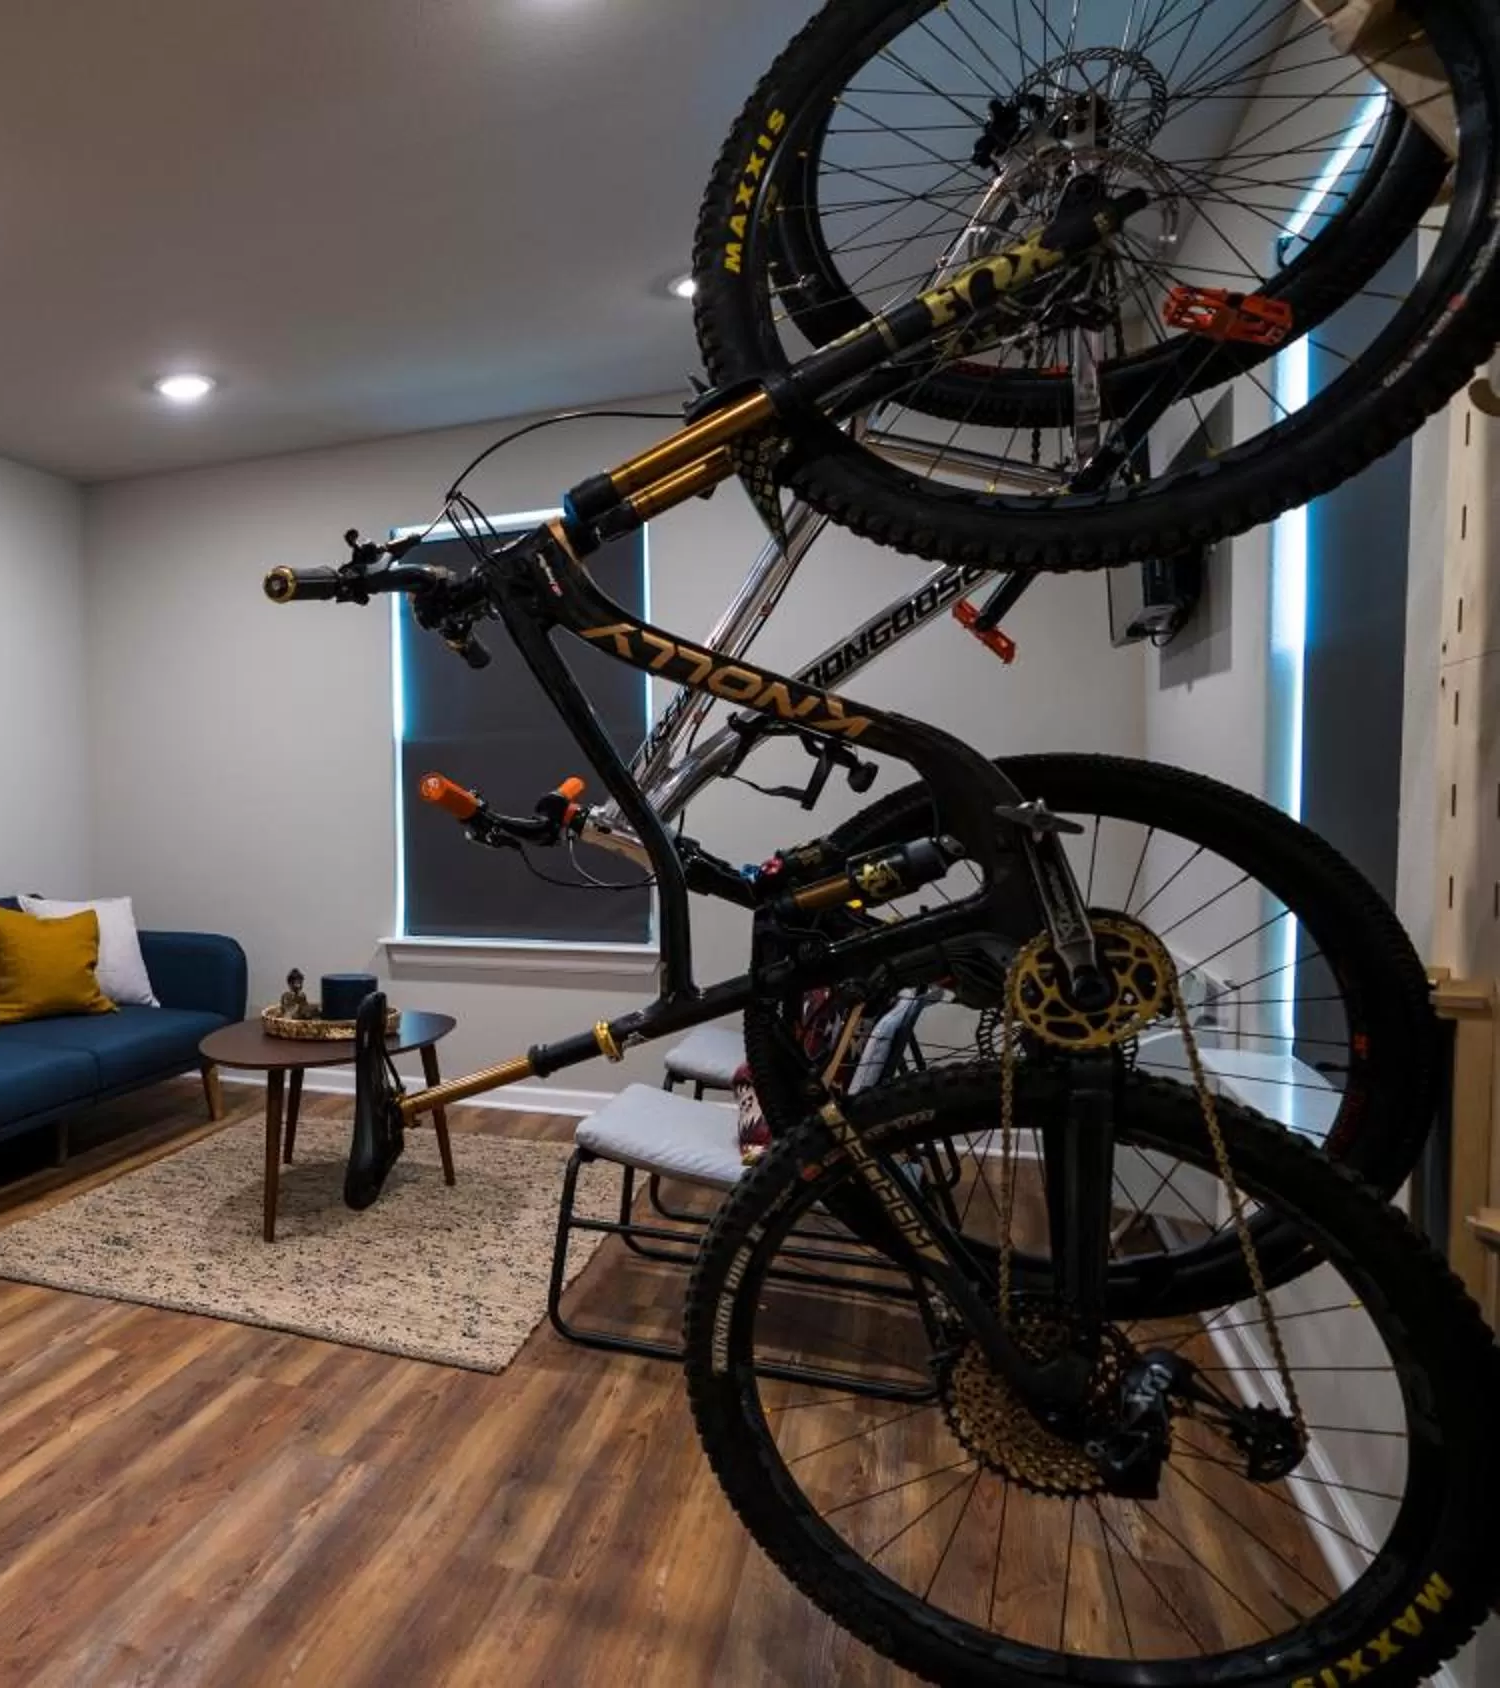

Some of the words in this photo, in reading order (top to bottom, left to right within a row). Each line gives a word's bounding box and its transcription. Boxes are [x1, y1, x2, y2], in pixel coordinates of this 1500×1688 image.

[723, 108, 788, 275] MAXXIS
[922, 229, 1065, 328] FOX
[579, 623, 873, 738] KNOLLY
